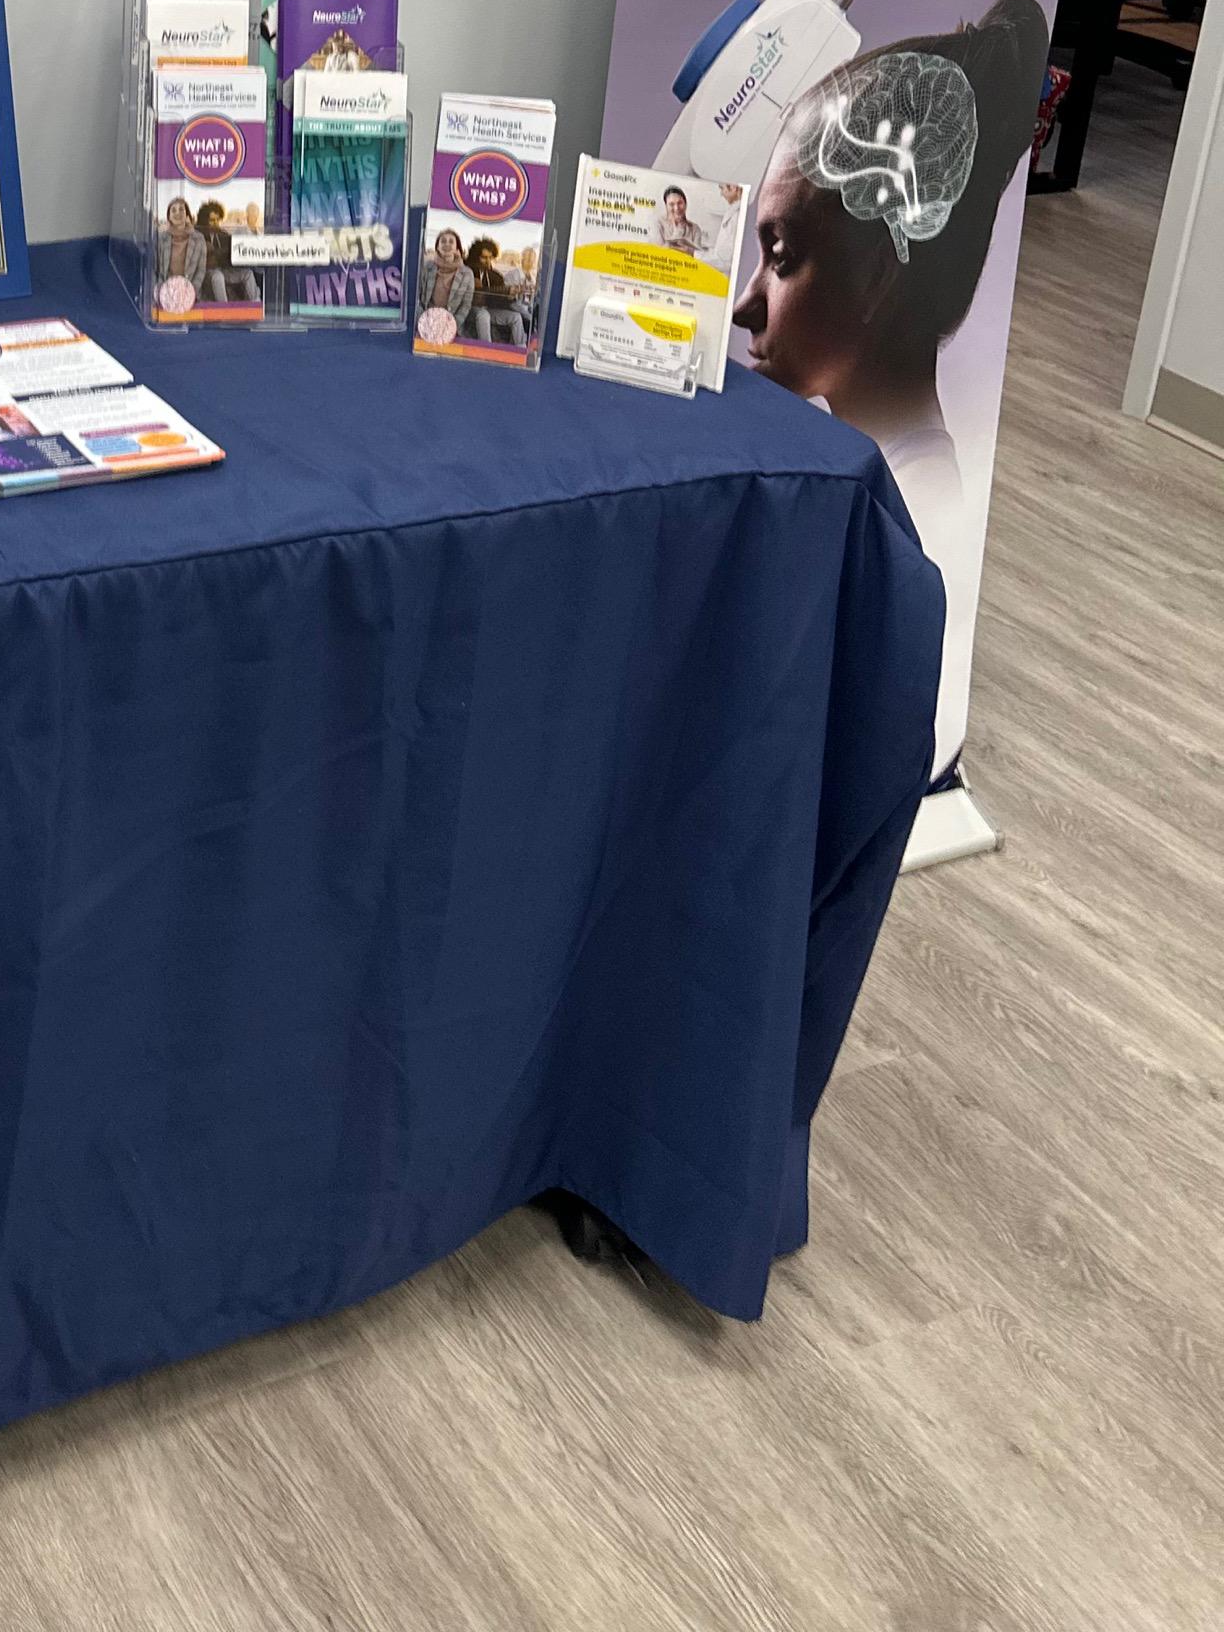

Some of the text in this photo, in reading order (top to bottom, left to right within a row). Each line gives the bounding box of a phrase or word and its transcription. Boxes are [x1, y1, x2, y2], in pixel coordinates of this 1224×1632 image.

[714, 40, 779, 130] NeuroStar
[474, 115, 523, 130] Northeast
[472, 127, 505, 138] Health
[506, 130, 547, 144] Services
[184, 138, 222, 152] WHAT
[463, 171, 517, 191] WHAT IS
[470, 189, 506, 206] TMS?
[305, 266, 402, 305] MYTHS
